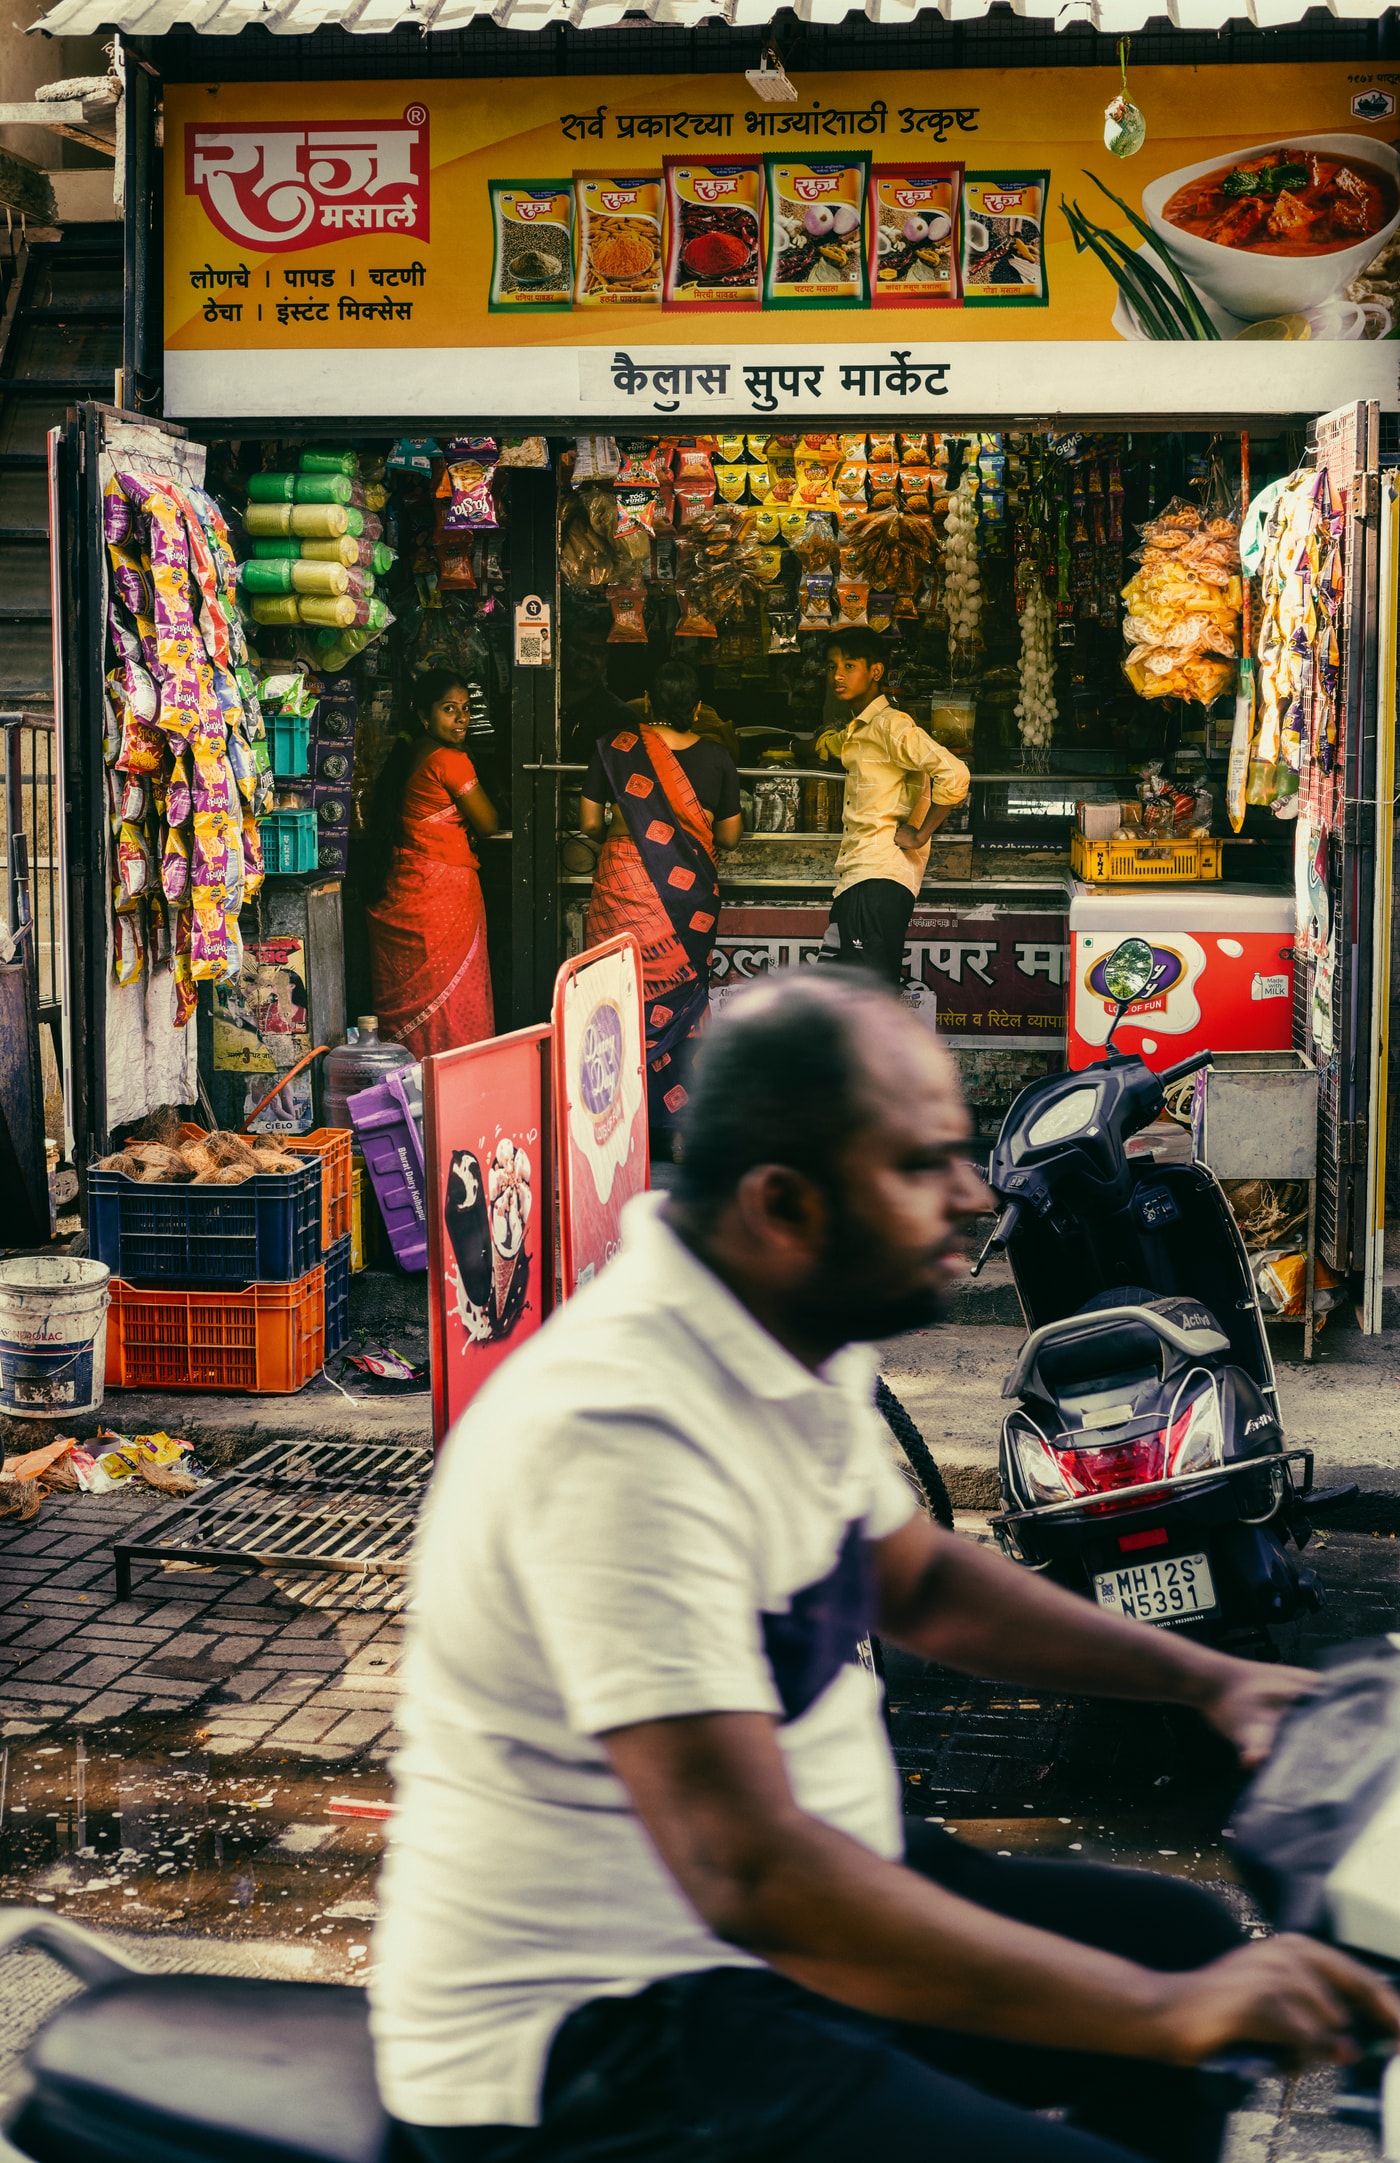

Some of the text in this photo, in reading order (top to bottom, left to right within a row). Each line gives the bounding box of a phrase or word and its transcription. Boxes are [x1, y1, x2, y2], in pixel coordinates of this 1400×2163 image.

[560, 101, 981, 143] सर्व प्रकारच्या भाज्यांसाठी उत्कृष्ट
[194, 130, 419, 242] राज
[319, 194, 418, 228] मसाले
[190, 261, 426, 288] लोणचे पापड चटणी
[203, 295, 413, 326] ठेचा इंस्टंट मिक्सेस
[743, 365, 824, 412] सुपर
[840, 351, 951, 397] मार्केट
[1055, 433, 1083, 456] GEMS
[451, 497, 491, 517] Pasta
[1264, 987, 1286, 996] MILK
[973, 1012, 983, 1027] व
[988, 1009, 1022, 1028] रिटेल
[1027, 1015, 1069, 1029] व्यापा
[1131, 1004, 1142, 1013] OF
[1143, 1000, 1162, 1011] FUN
[265, 1122, 293, 1130] CIELO
[398, 1147, 426, 1222] Bharat Dairy Kolhapur
[1183, 1313, 1211, 1331] Activa
[1116, 1559, 1196, 1597] MH12S
[1102, 1595, 1116, 1605] IND
[1121, 1584, 1198, 1619] N5391
